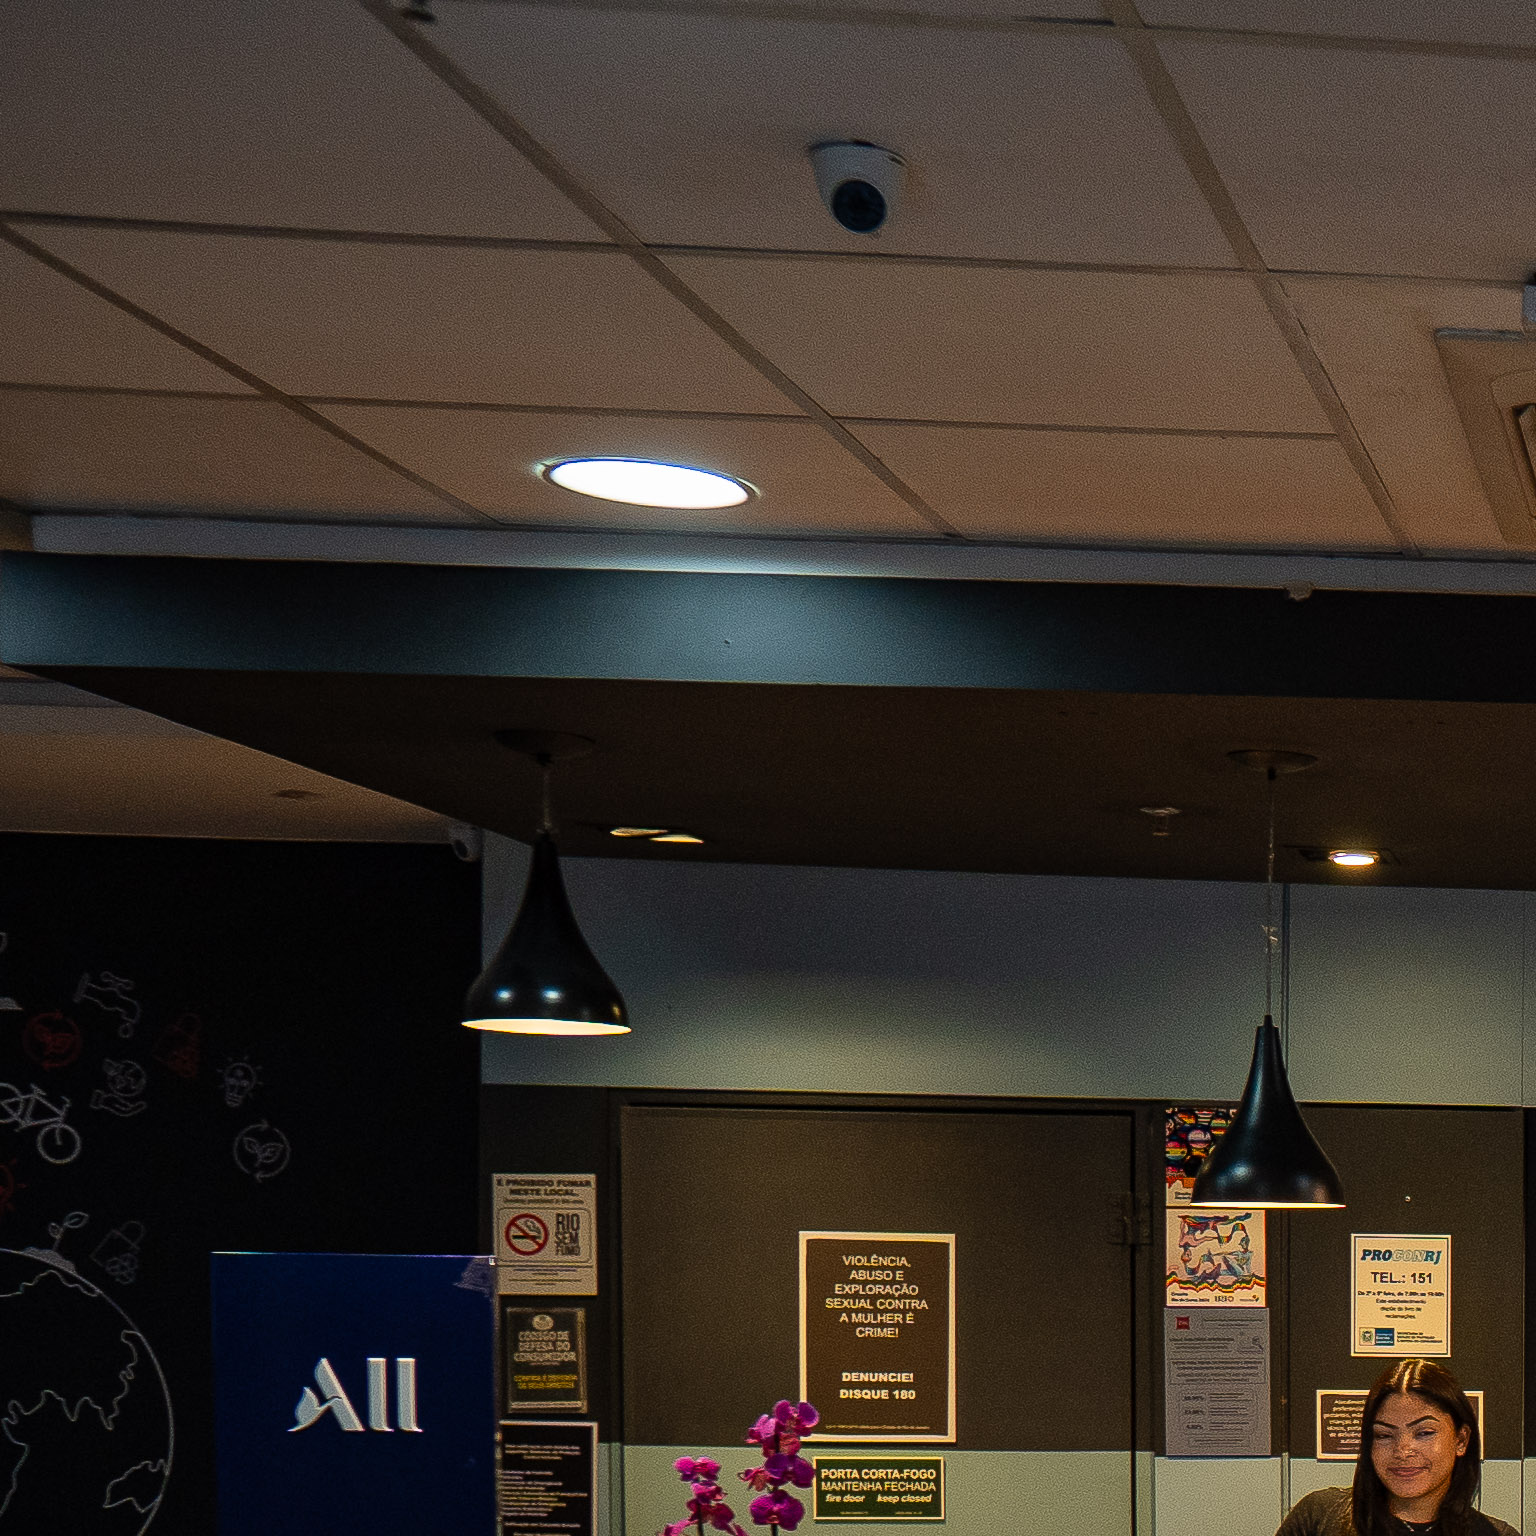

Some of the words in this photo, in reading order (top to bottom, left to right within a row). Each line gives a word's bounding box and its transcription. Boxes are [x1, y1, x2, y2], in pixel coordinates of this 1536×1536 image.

[555, 1212, 581, 1232] RIO
[555, 1230, 580, 1244] SEM
[842, 1254, 911, 1267] VIOLÊNCIA,
[849, 1270, 893, 1281] ABUSO
[895, 1270, 904, 1281] E
[1371, 1271, 1406, 1284] TEL.:
[1410, 1272, 1433, 1284] 151
[834, 1283, 919, 1297] EXPLORAÇÃO
[825, 1298, 873, 1309] SEXUAL
[876, 1299, 929, 1310] CONTRA
[839, 1312, 849, 1323] A
[851, 1312, 903, 1324] MULHER
[855, 1327, 899, 1338] CRIME!
[841, 1372, 914, 1382] DENUNCIE!
[839, 1389, 889, 1400] DISQUE
[892, 1389, 916, 1400] 180
[821, 1469, 860, 1480] PORTA
[861, 1469, 936, 1480] CORTA-FOGO
[821, 1481, 883, 1492] MANTENHA
[883, 1481, 937, 1492] FECHADA
